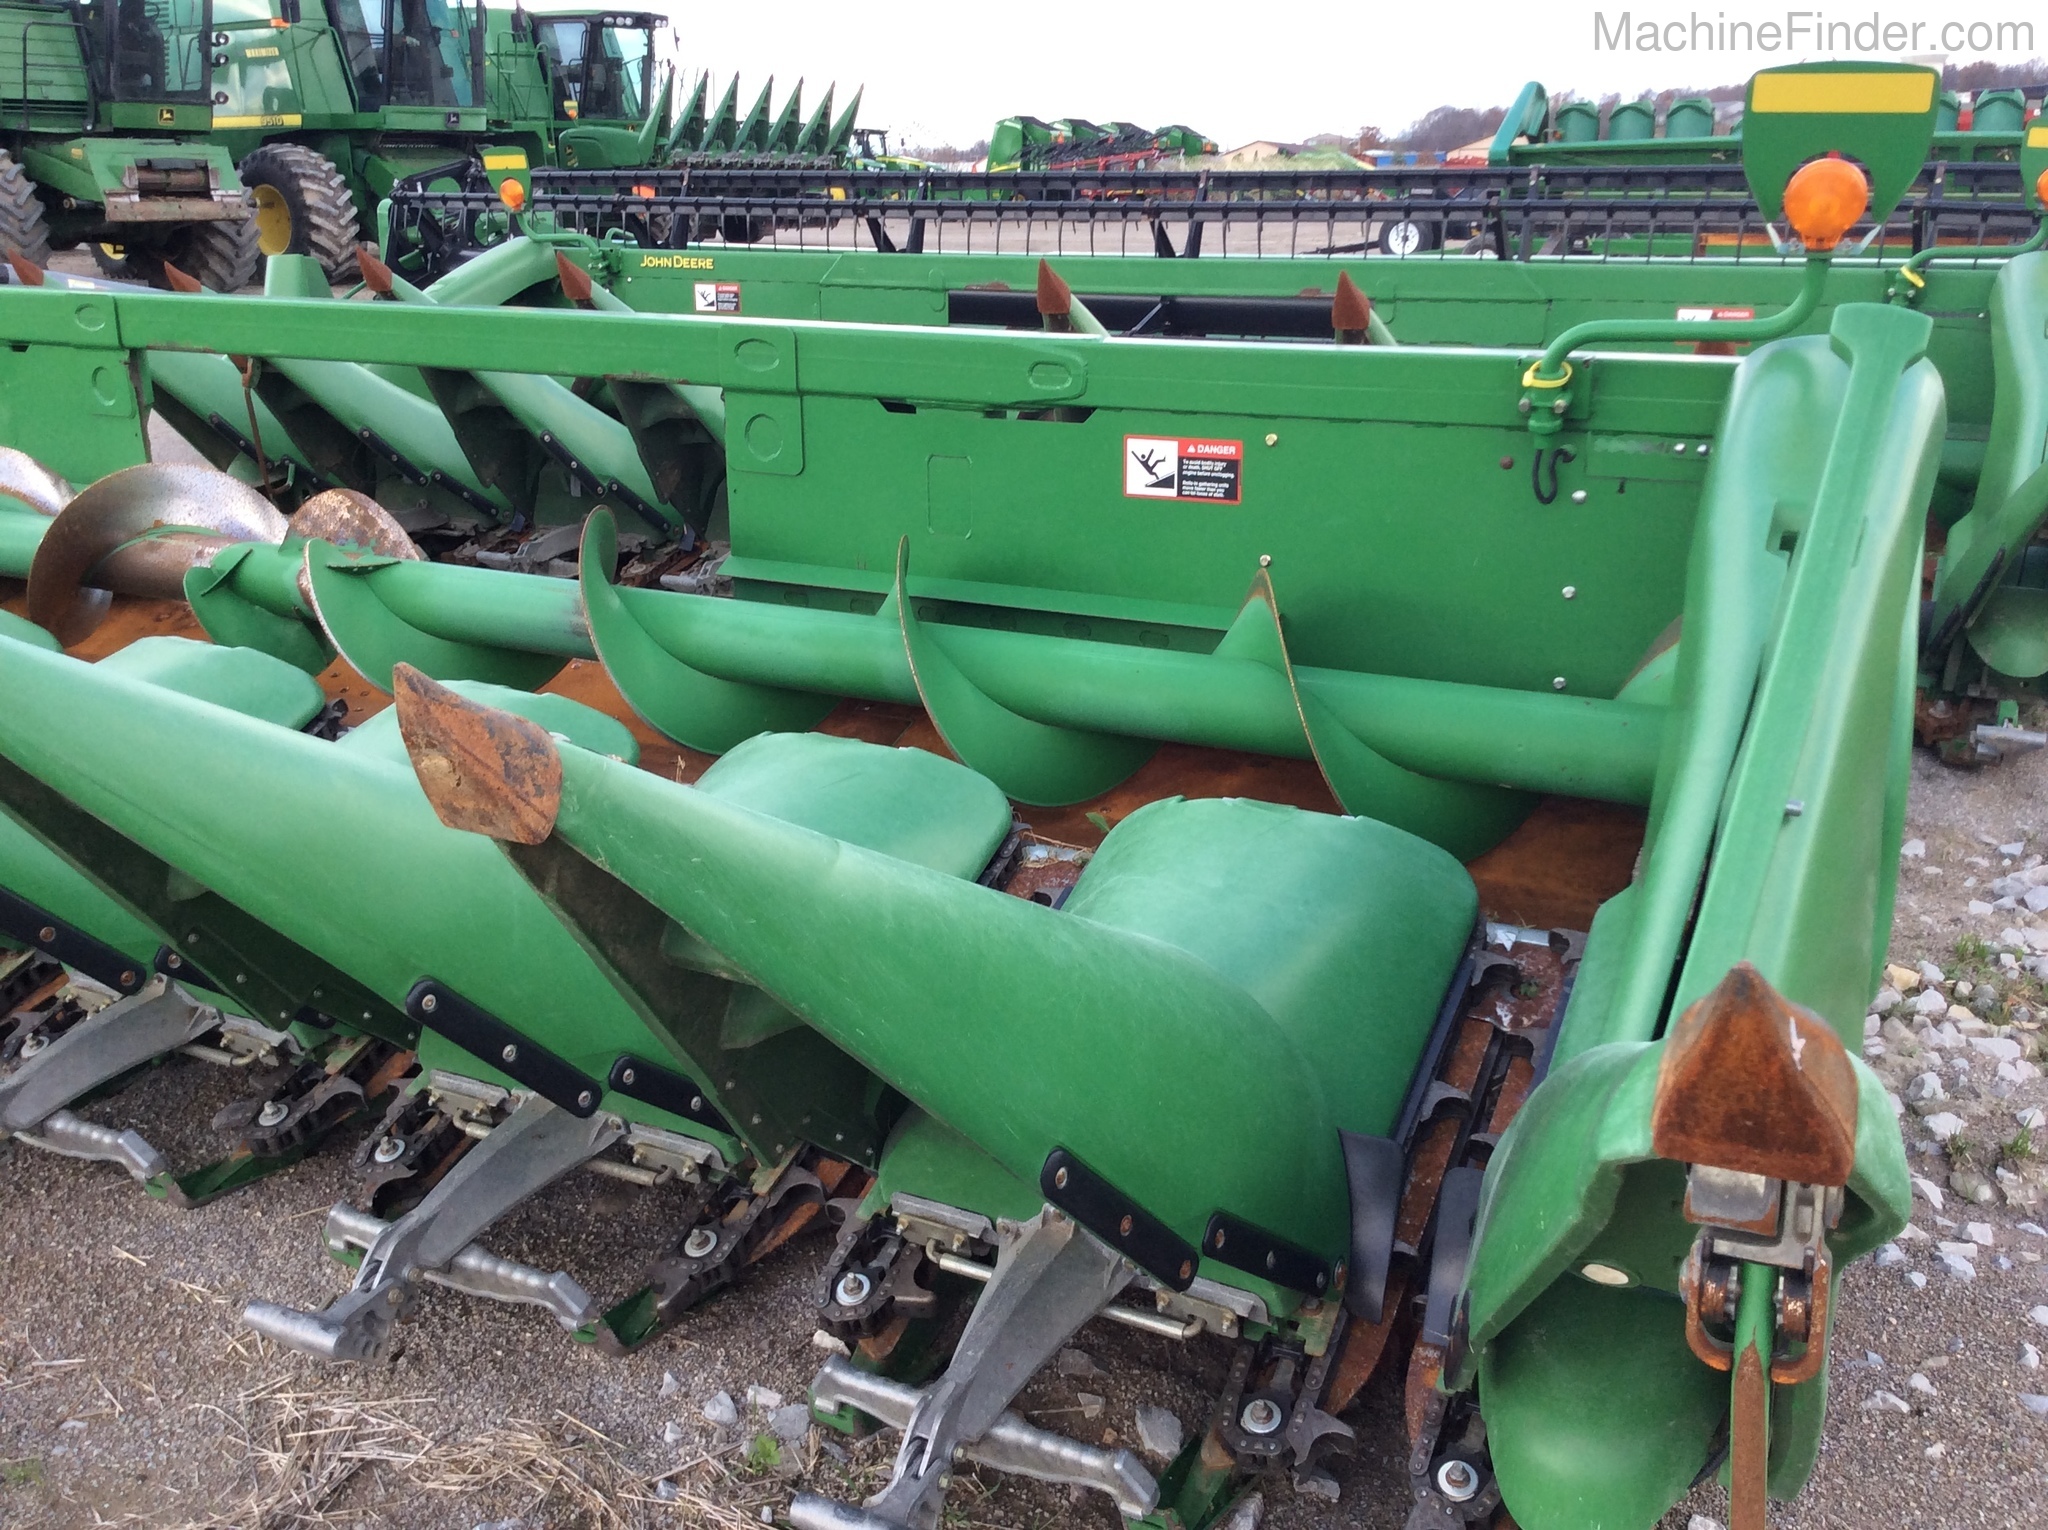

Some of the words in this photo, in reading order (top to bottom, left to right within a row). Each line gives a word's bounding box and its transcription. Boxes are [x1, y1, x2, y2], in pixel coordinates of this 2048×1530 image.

[640, 255, 672, 268] JOHN
[673, 255, 714, 269] DEERE
[1196, 444, 1236, 455] DANGER
